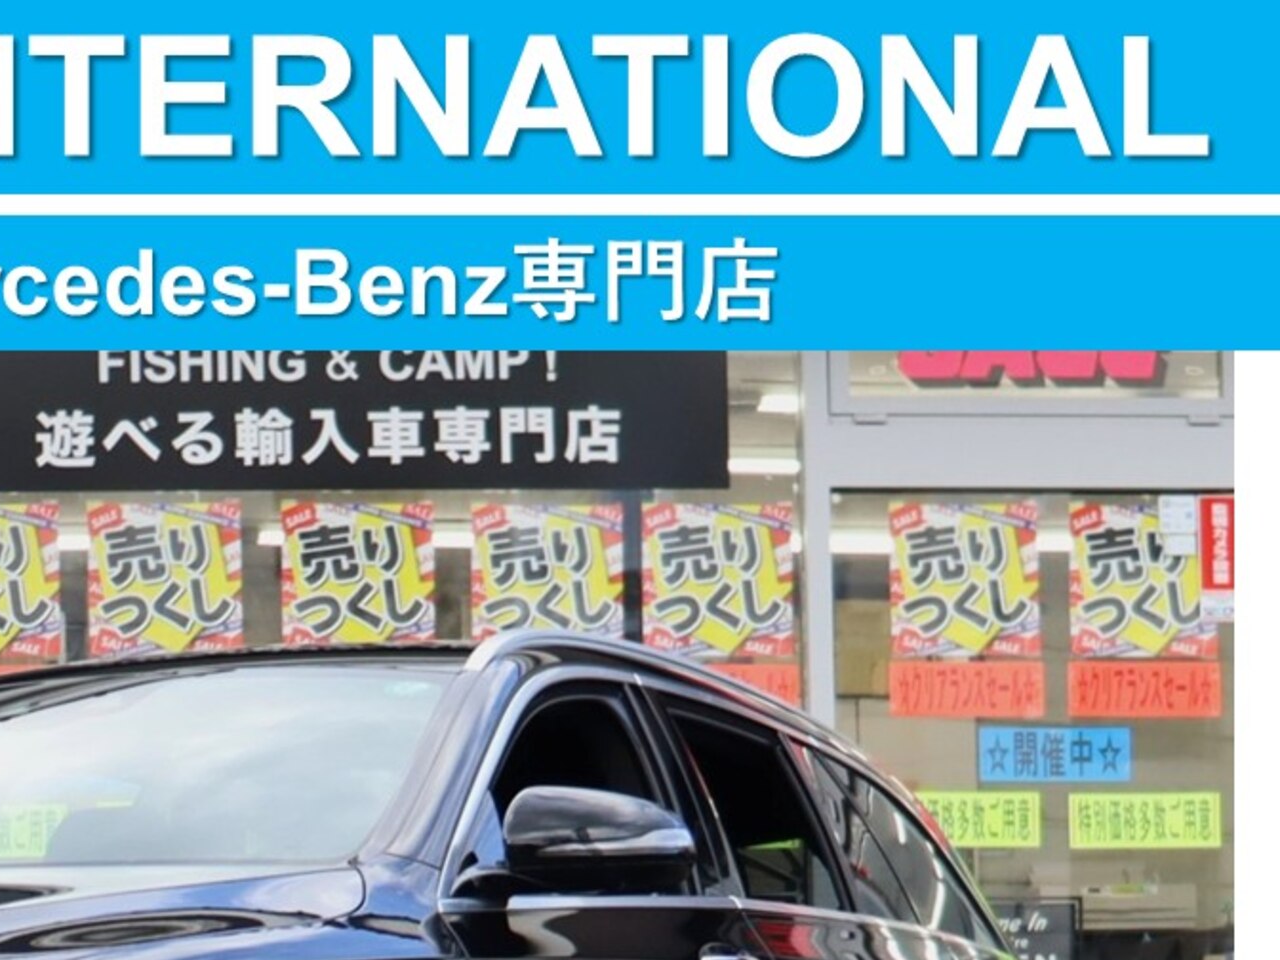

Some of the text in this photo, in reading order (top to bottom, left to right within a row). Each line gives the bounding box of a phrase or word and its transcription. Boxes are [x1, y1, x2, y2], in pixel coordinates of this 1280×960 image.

[98, 350, 307, 383] FISHING
[326, 350, 359, 381] &
[35, 405, 623, 468] 遊べる輸入車専門店
[103, 524, 208, 588] 売り
[297, 524, 400, 587] 売り
[487, 525, 589, 588] 売り
[657, 524, 758, 587] 売り
[905, 524, 1004, 587] 売り
[100, 577, 233, 636] つくし
[293, 577, 424, 635] つくし
[482, 578, 613, 631] つくし
[653, 578, 782, 634] つくし
[902, 578, 1028, 634] つくし
[1081, 580, 1201, 635] つくし
[1013, 731, 1093, 778] 開催中
